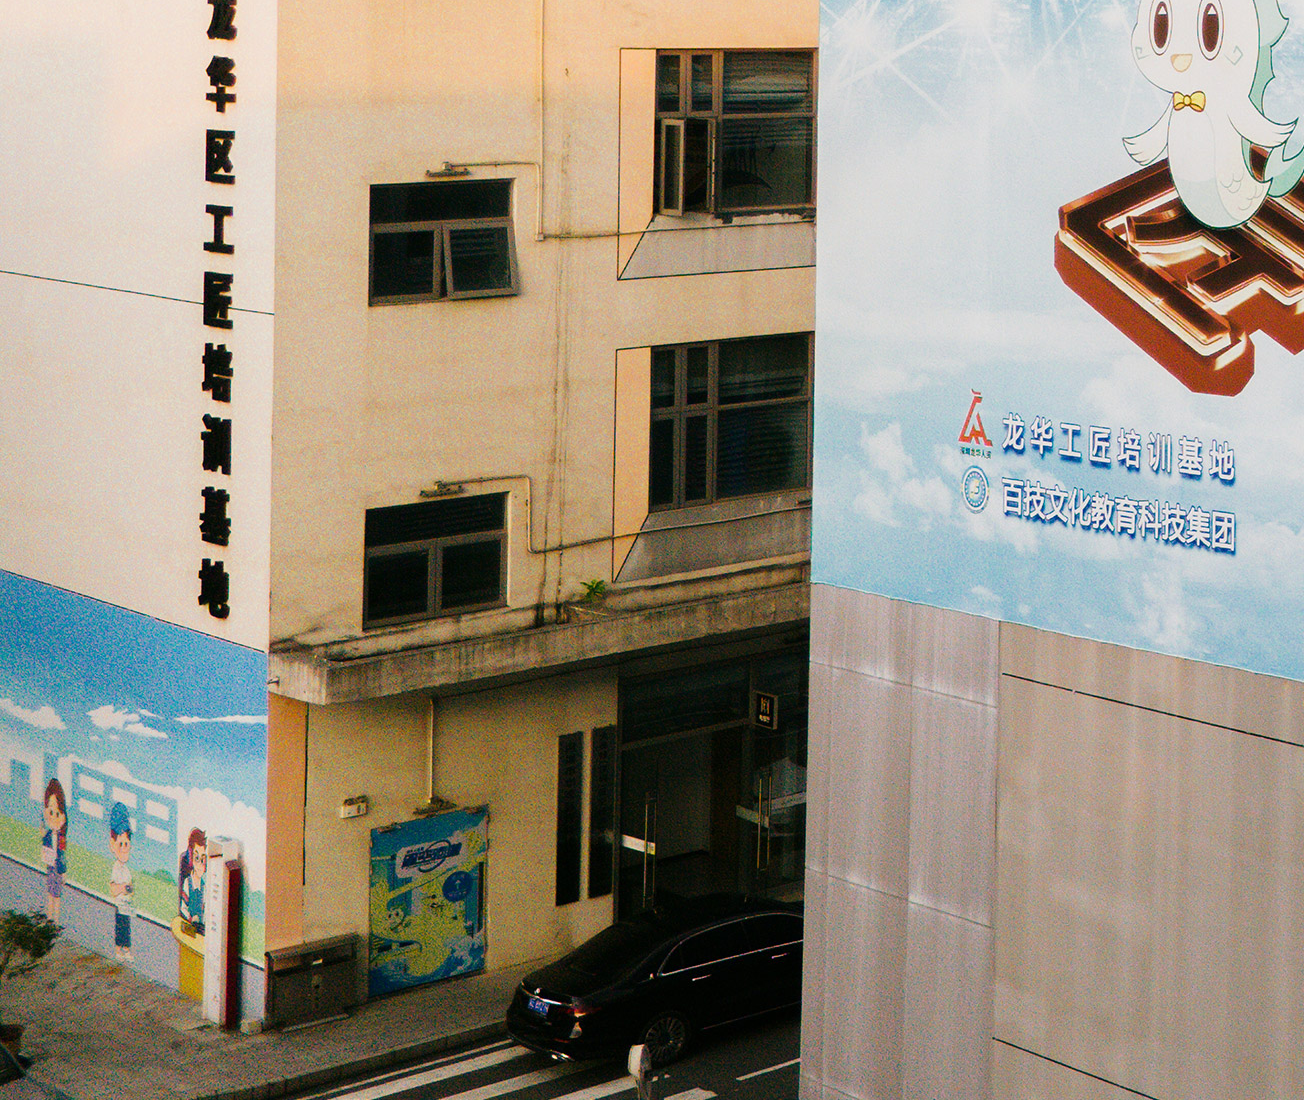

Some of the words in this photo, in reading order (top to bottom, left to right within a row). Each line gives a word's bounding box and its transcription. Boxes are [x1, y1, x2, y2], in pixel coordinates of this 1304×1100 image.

[1001, 411, 1236, 483] 龙华工匠培训基地
[1001, 476, 1237, 553] 百技文化教育科技集团
